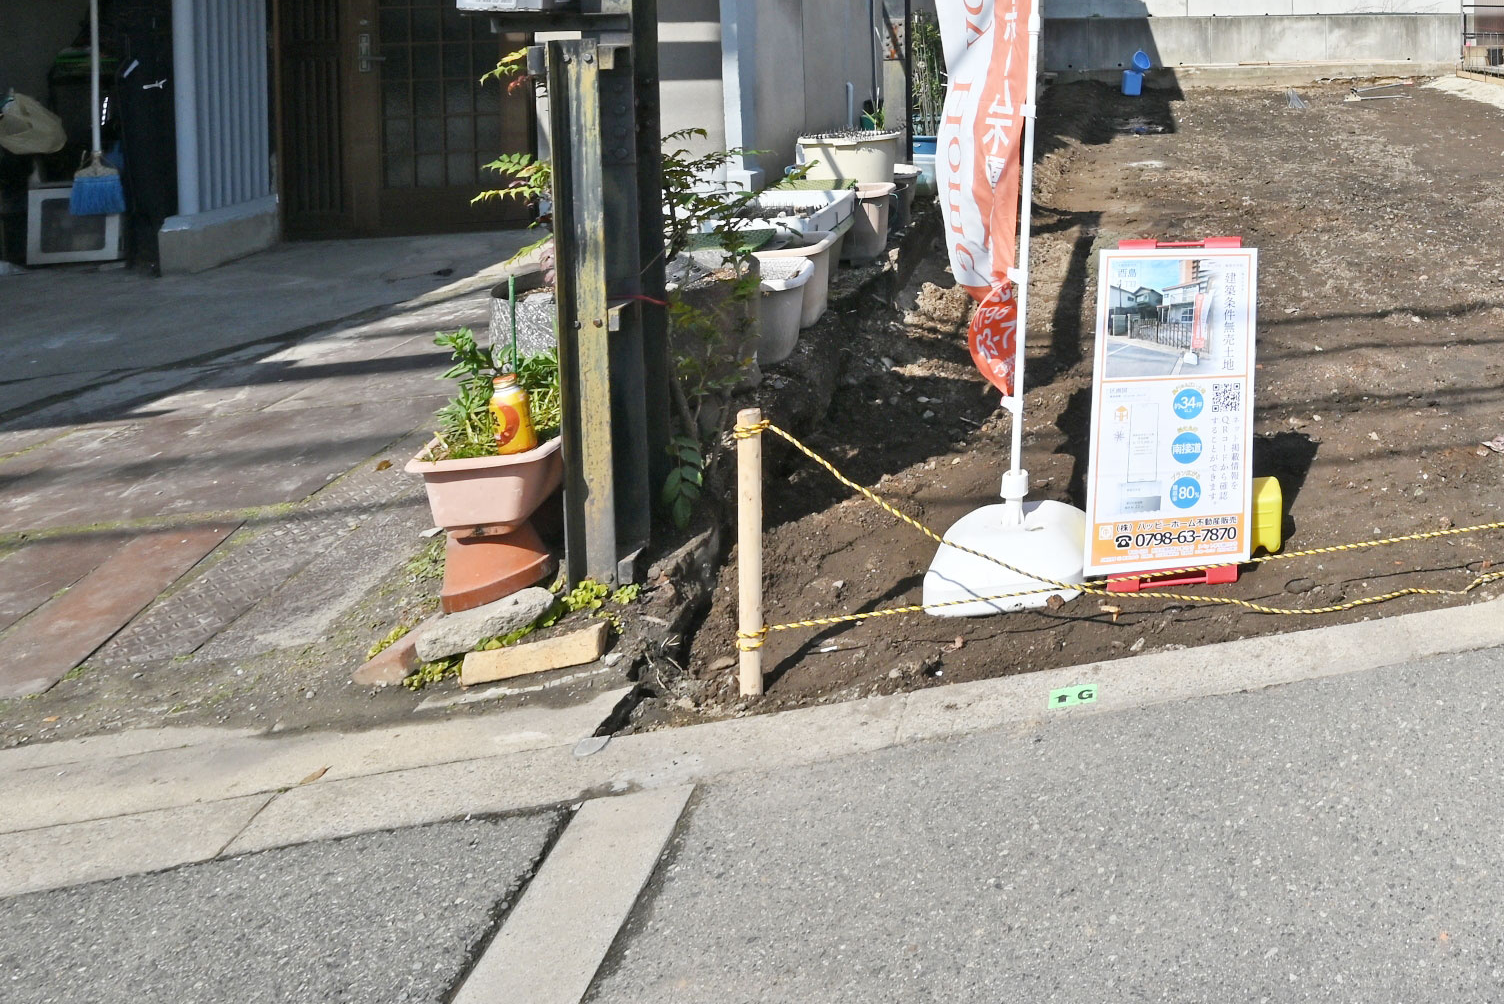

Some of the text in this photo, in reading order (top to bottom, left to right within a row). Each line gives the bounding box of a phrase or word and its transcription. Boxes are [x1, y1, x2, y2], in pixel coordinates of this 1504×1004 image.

[1221, 272, 1237, 371] 建築条件無売土地
[1135, 527, 1237, 547] 0798-63-7870
[1077, 689, 1093, 700] G
